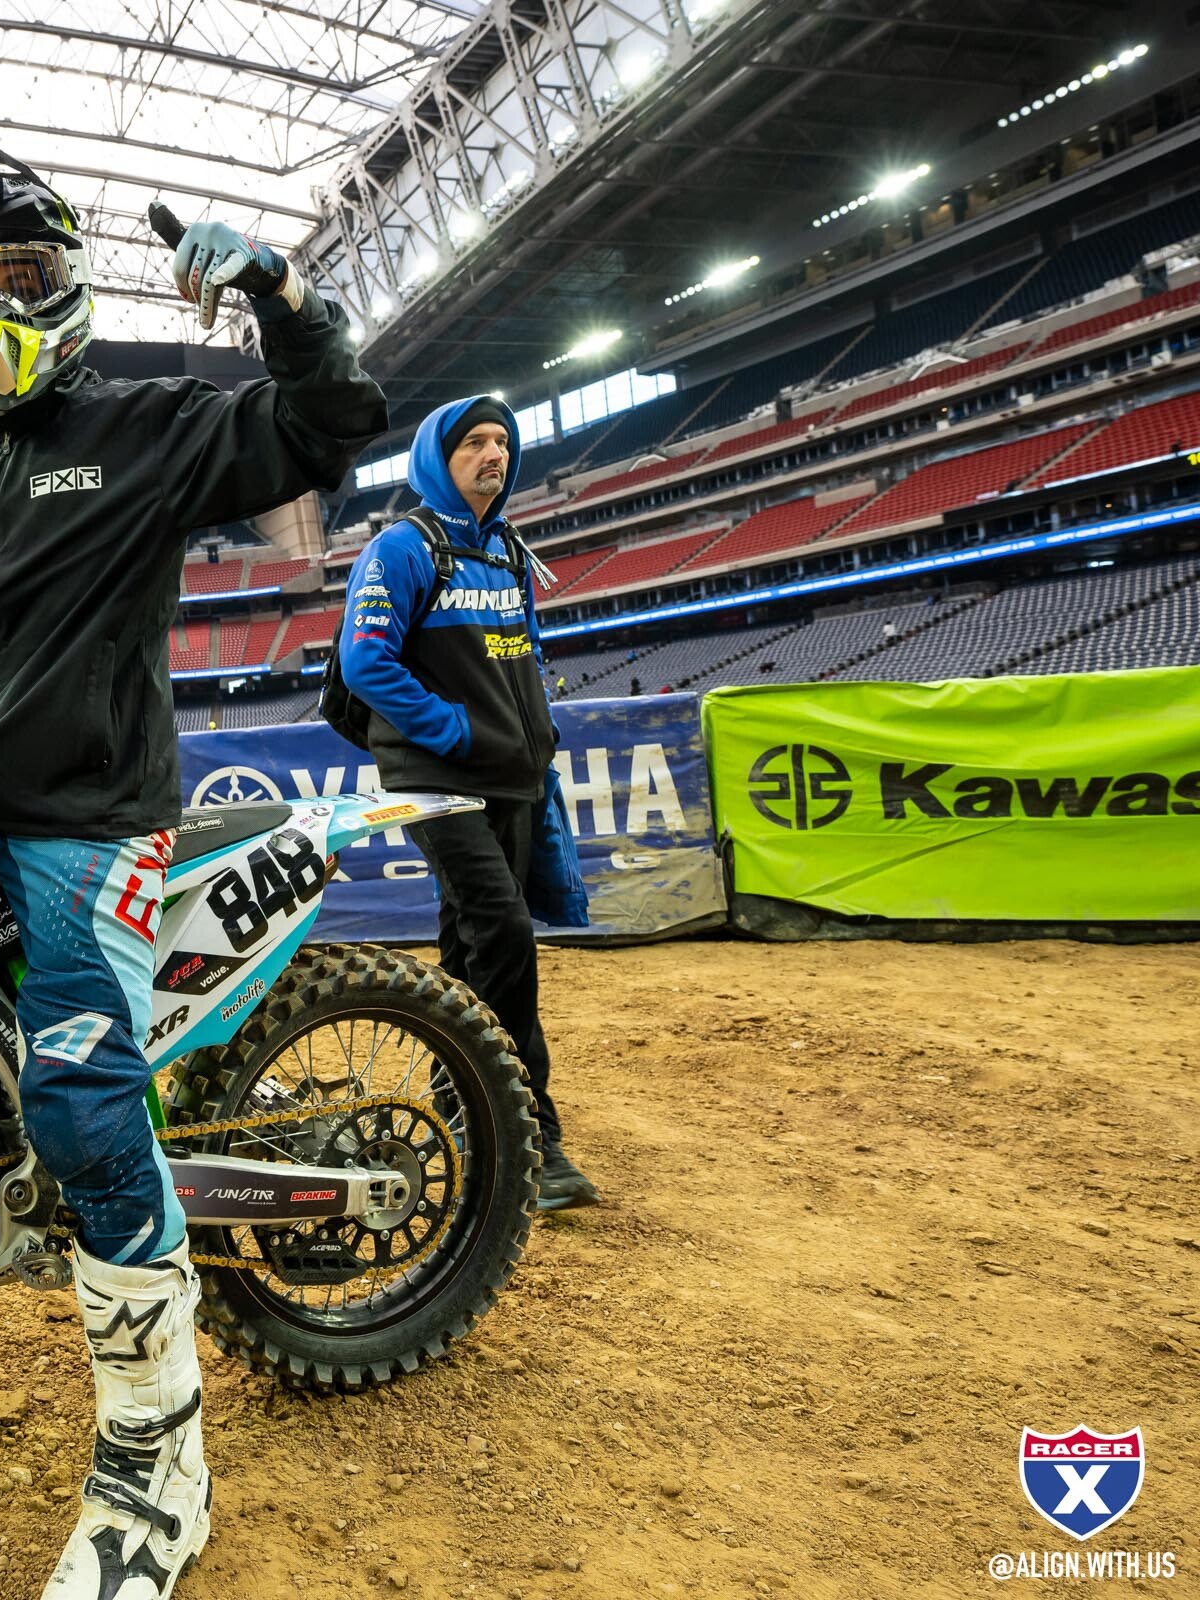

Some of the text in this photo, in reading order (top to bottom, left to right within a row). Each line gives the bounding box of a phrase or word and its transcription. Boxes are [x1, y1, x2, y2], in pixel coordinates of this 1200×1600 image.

[30, 466, 101, 498] FXR
[879, 760, 1200, 820] Kawas
[206, 827, 325, 954] 848
[200, 964, 229, 988] value.
[222, 978, 264, 1021] motolife
[143, 1005, 190, 1051] XR
[205, 1188, 275, 1200] SUNSTAR
[291, 1191, 335, 1201] BRAKING
